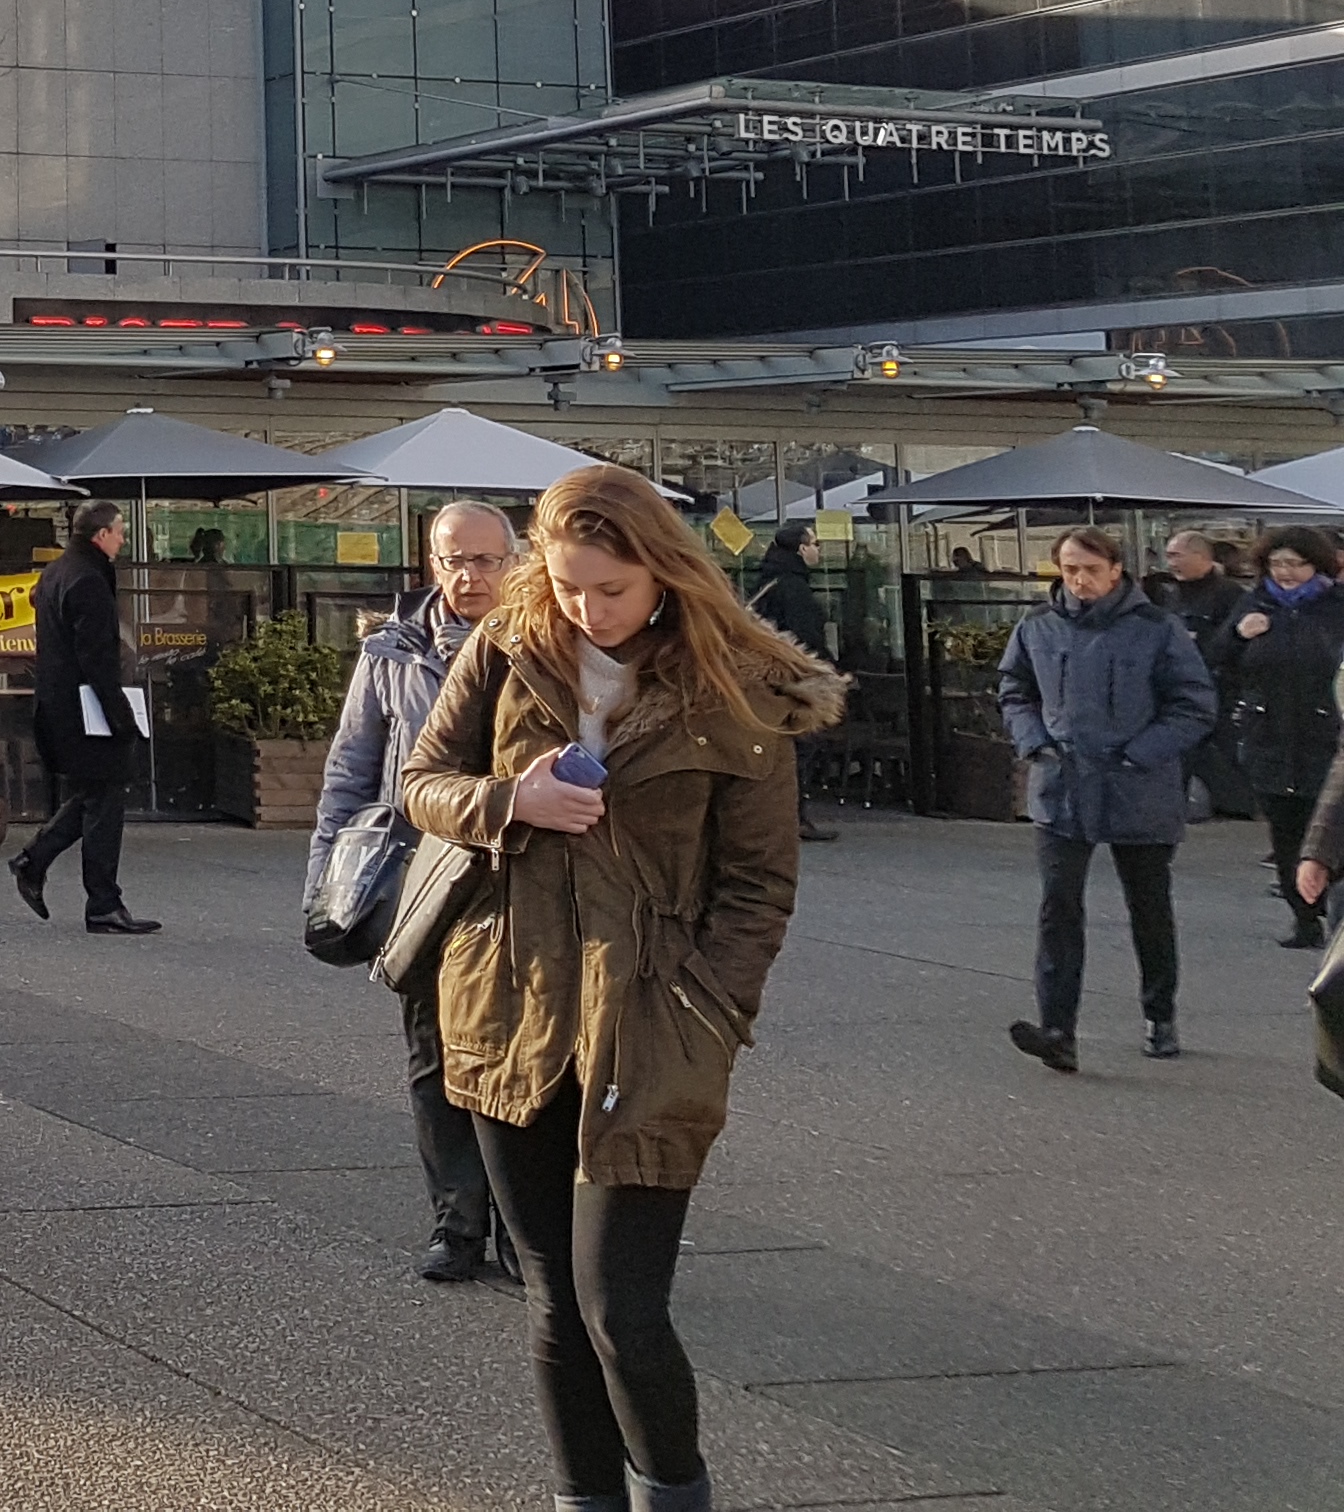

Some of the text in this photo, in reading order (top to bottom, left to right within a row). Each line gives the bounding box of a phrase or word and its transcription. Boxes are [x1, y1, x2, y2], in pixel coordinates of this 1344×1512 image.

[737, 112, 1112, 159] LES QUATRE TEMPS
[154, 626, 208, 648] Brasserie
